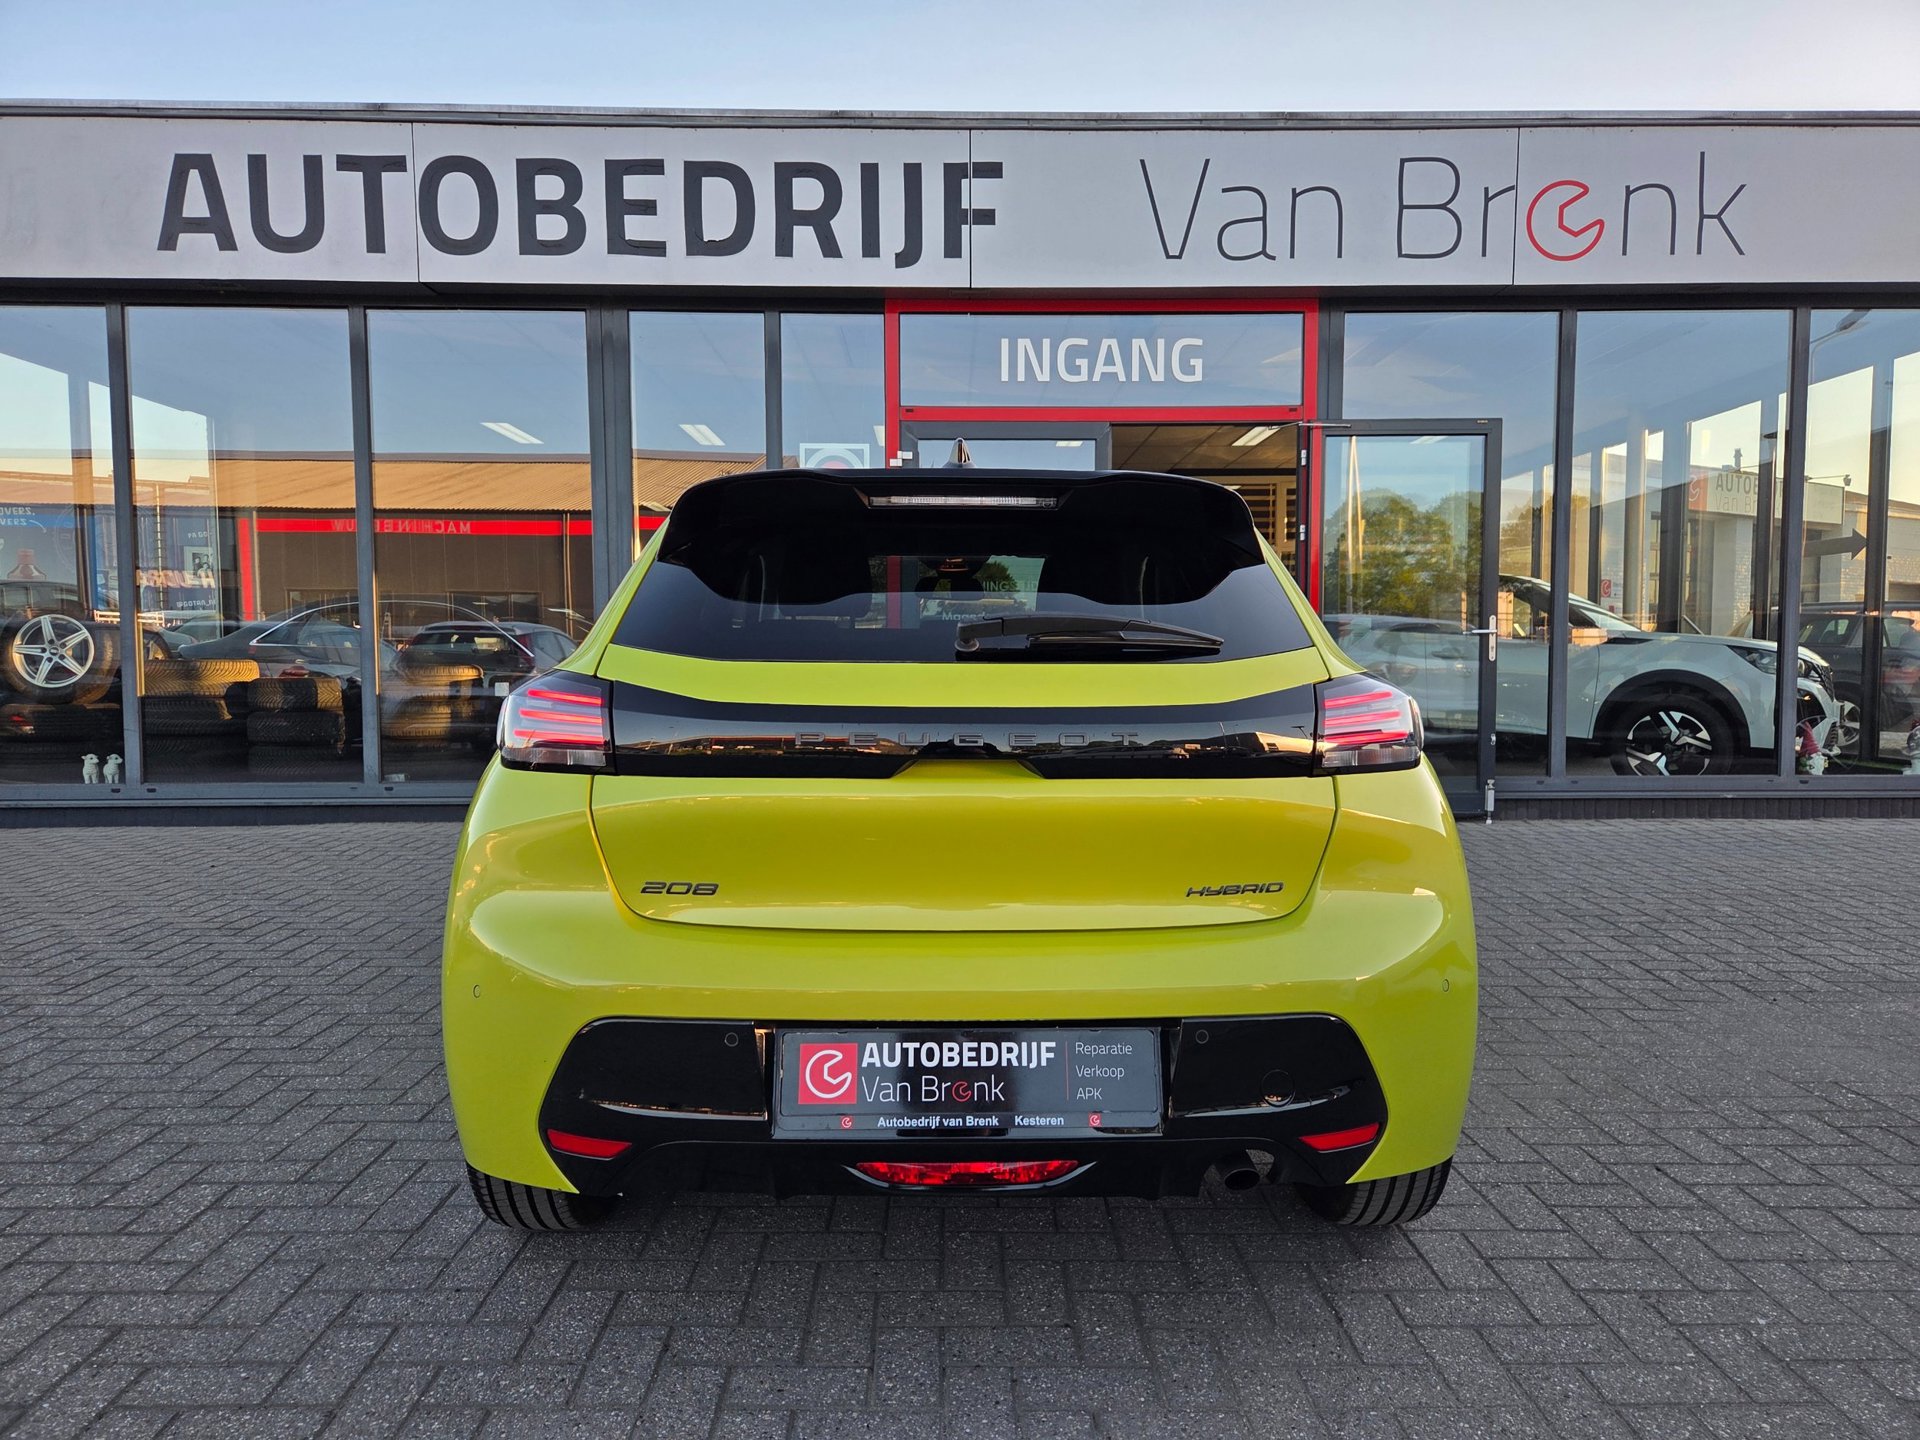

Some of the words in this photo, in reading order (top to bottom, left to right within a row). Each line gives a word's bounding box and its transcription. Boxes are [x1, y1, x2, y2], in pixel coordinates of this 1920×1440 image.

[157, 153, 1003, 269] AUTOBEDRIJF
[1139, 158, 1343, 261] Van
[1001, 338, 1203, 382] INGANG
[795, 731, 1138, 746] PEUGEOT
[640, 881, 719, 896] 208
[1185, 881, 1284, 897] HYBRID
[861, 1042, 1056, 1068] AUTOBEDRIJF
[1075, 1042, 1132, 1057] Reparatie
[1076, 1065, 1125, 1079] Verkoop
[862, 1076, 910, 1102] Van
[1076, 1087, 1102, 1100] APK
[877, 1116, 940, 1129] Autobedrijf
[942, 1118, 965, 1127] van
[966, 1116, 999, 1126] Brenk
[1015, 1116, 1064, 1126] Kesteren
